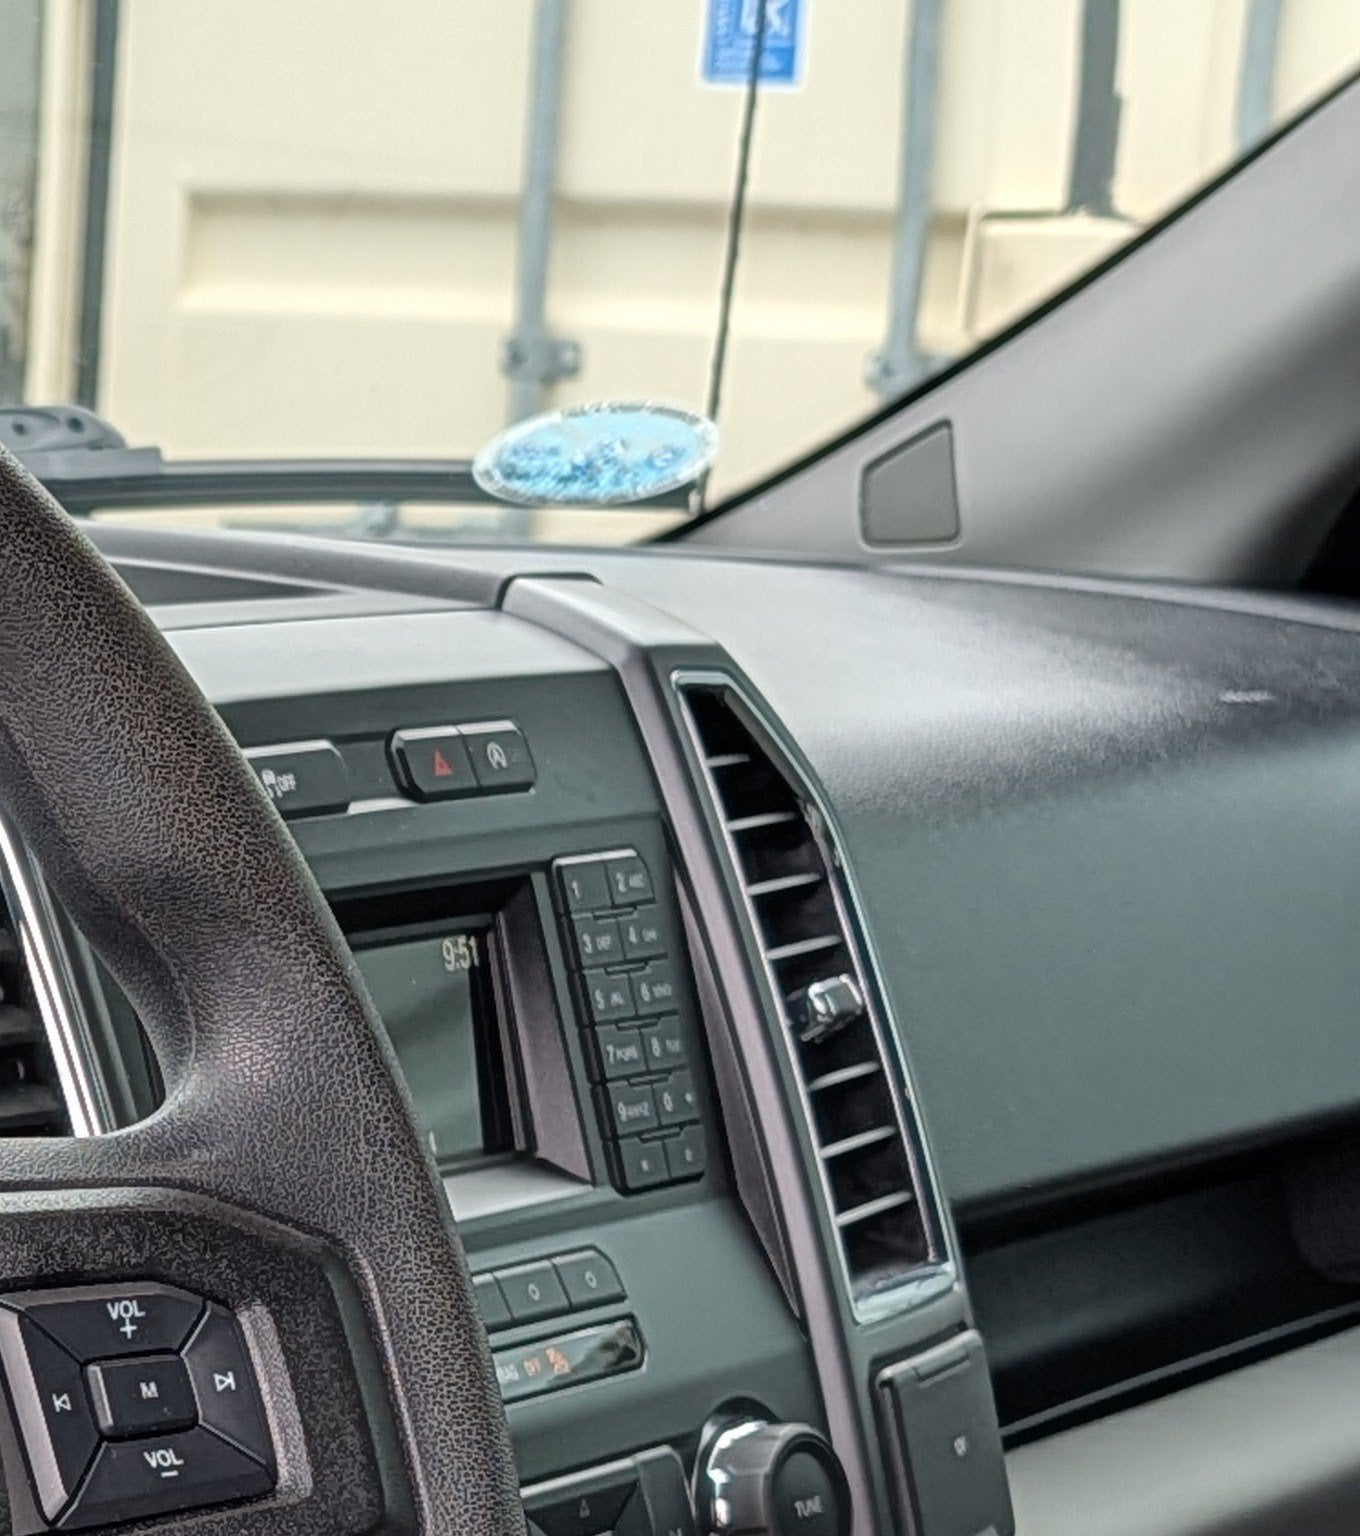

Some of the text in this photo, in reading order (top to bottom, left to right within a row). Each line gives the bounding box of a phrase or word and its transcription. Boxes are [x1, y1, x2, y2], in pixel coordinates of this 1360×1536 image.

[616, 872, 626, 892] 2
[443, 935, 479, 971] 9:51
[582, 933, 592, 954] 3
[595, 989, 605, 1010] 5
[641, 982, 651, 1002] 6
[606, 1044, 615, 1065] 7
[107, 1301, 146, 1320] VOL
[140, 1382, 158, 1399] M
[144, 1450, 183, 1469] VOL
